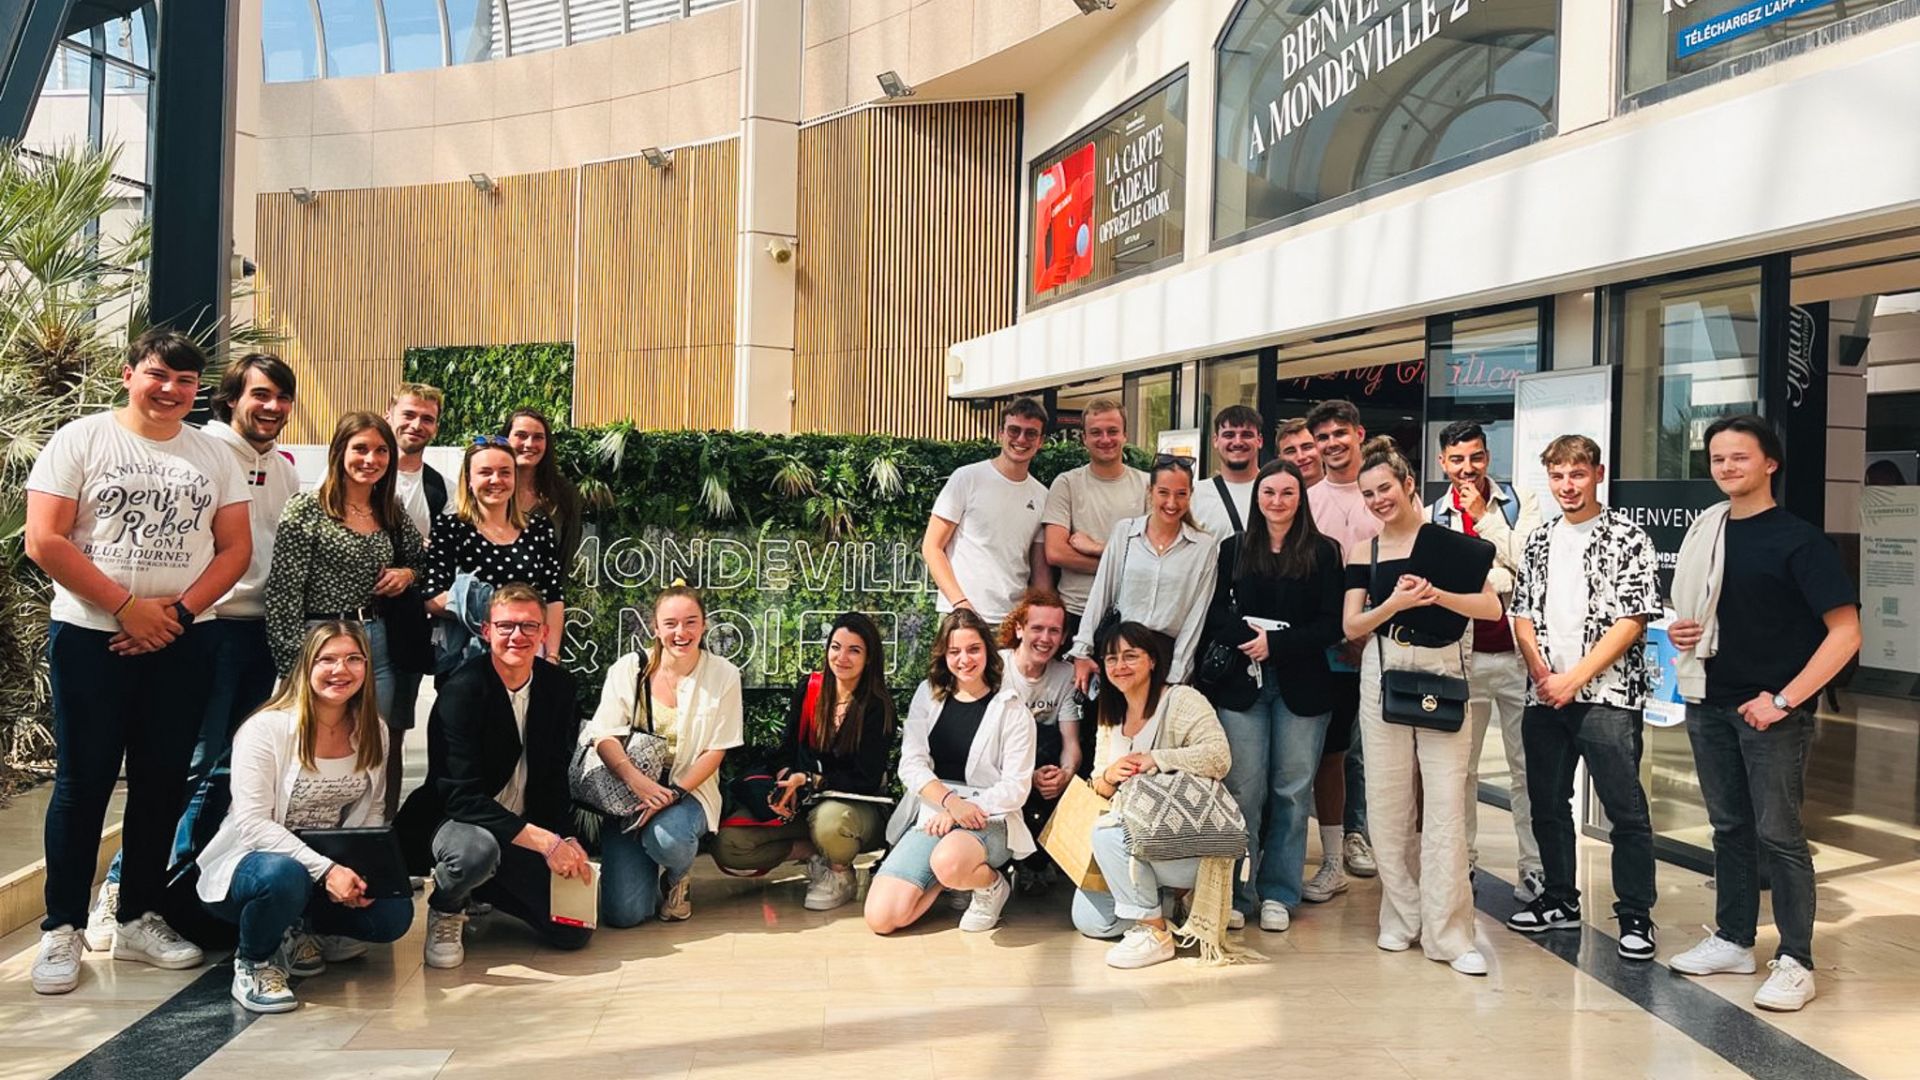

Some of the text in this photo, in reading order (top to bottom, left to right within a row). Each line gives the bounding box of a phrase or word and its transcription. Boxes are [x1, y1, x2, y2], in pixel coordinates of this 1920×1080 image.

[1281, 0, 1380, 81] BIENVE
[1684, 8, 1763, 47] TÉLÉCHARGEZ
[1249, 114, 1265, 160] A
[1268, 0, 1441, 146] MONDEVILLE
[1105, 151, 1121, 186] LA
[1122, 123, 1164, 173] CARTE
[1111, 161, 1159, 214] CADEAU
[1099, 188, 1170, 244] OFFREZ LE CHOIX
[102, 463, 209, 488] AMERICAN
[95, 482, 205, 519] Denim
[1620, 507, 1704, 527] BIENVEN
[112, 500, 205, 548] Rebel
[153, 536, 185, 550] ON A
[83, 544, 193, 562] BLUE JOURNEY
